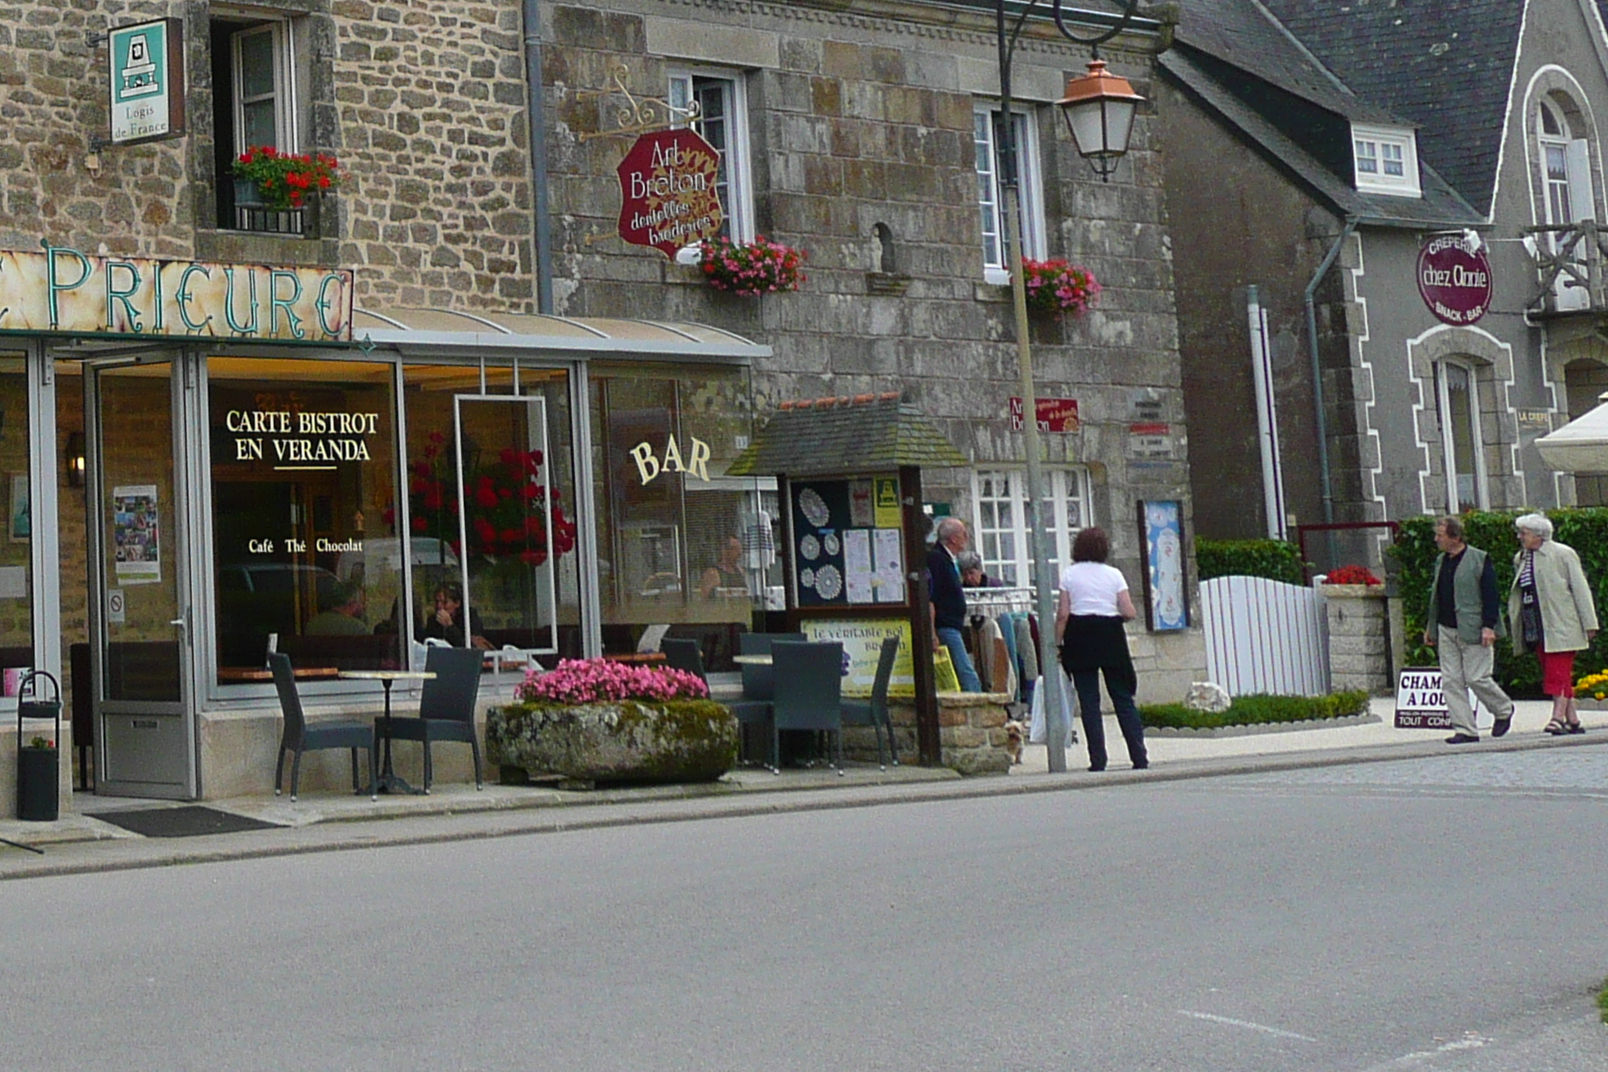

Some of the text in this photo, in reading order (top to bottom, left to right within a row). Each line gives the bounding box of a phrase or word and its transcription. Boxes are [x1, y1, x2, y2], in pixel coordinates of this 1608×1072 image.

[126, 105, 155, 120] Logis
[115, 122, 167, 139] de France
[651, 138, 684, 168] Art
[631, 168, 706, 199] Breton
[631, 200, 691, 231] dentelles
[648, 216, 711, 245] broderies
[1423, 264, 1452, 287] chez
[41, 237, 349, 339] PRIEURE
[1012, 398, 1023, 414] Ar
[226, 410, 379, 434] CARTE BISTROT
[1012, 415, 1049, 432] Bron
[235, 438, 371, 461] EN VERANDA
[629, 432, 711, 486] BAR
[248, 538, 363, 553] Café Thé Chocolat
[1406, 692, 1417, 706] A
[1399, 716, 1422, 726] TOUT
